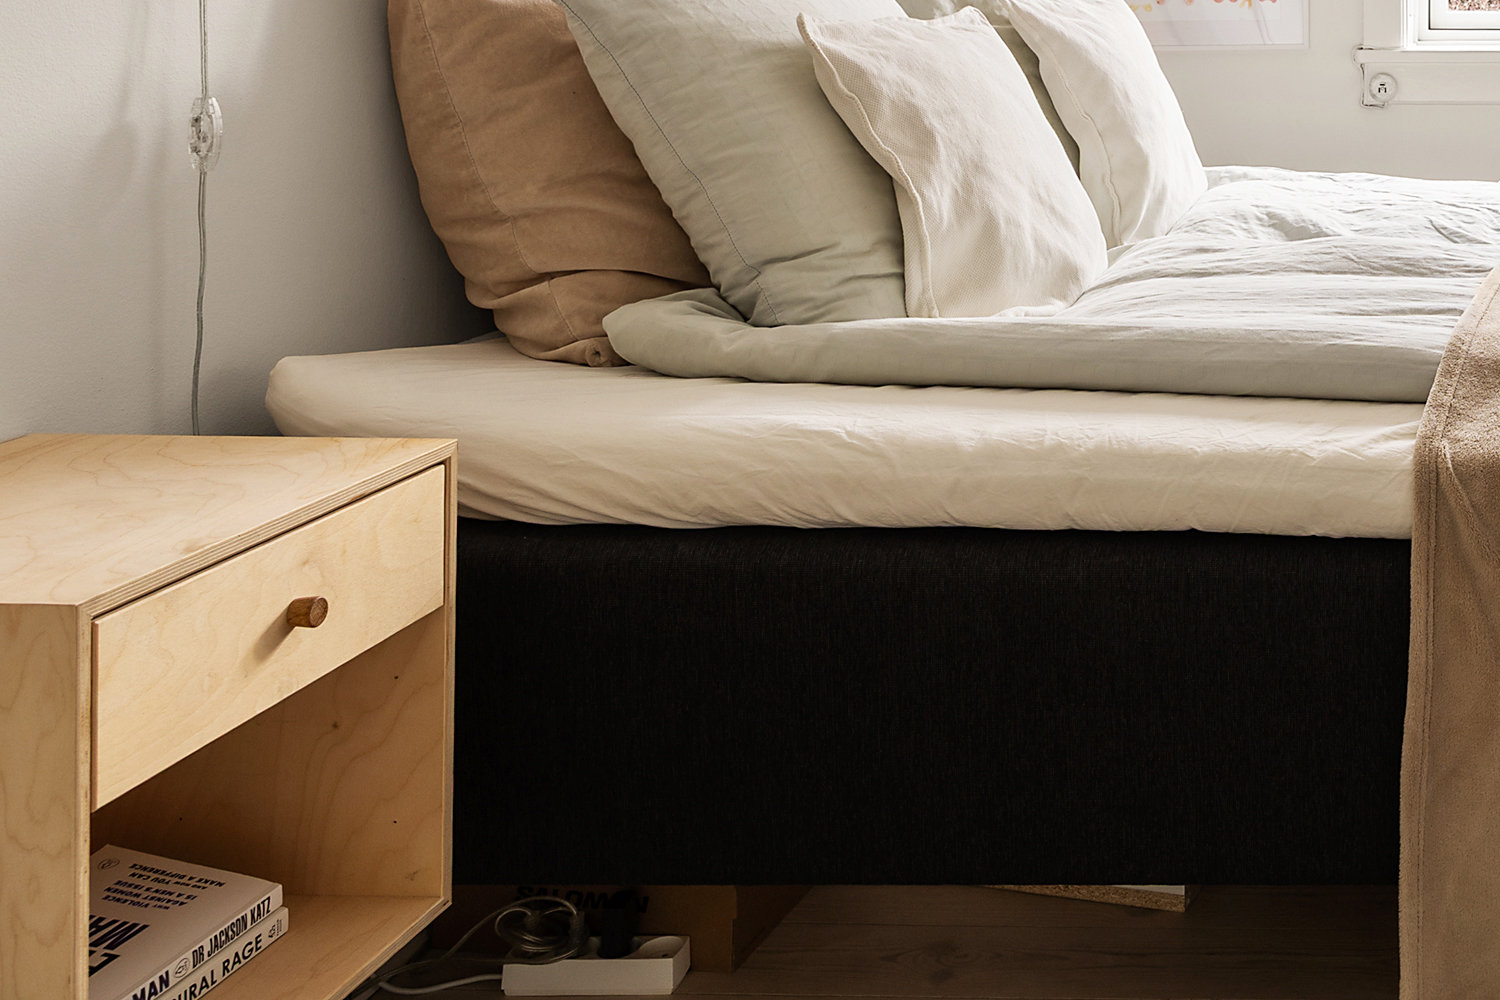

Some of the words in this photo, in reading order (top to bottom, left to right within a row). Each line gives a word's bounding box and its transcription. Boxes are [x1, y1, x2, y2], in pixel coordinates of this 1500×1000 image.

[128, 863, 187, 880] DIFFERENCE
[128, 872, 151, 881] CAN
[113, 880, 145, 890] ISSUE
[150, 876, 172, 885] YOU
[195, 878, 226, 887] MAKE
[103, 887, 142, 898] WOMEN
[102, 894, 150, 909] VIOLENCE
[142, 895, 188, 906] AGAINST
[515, 886, 650, 914] SALOMN
[132, 969, 170, 1000] MAN
[192, 945, 205, 969] DR
[207, 913, 248, 958] JACKSON
[250, 896, 271, 926] KATZ
[172, 970, 217, 1000] URAL
[222, 933, 262, 978] RAGE
